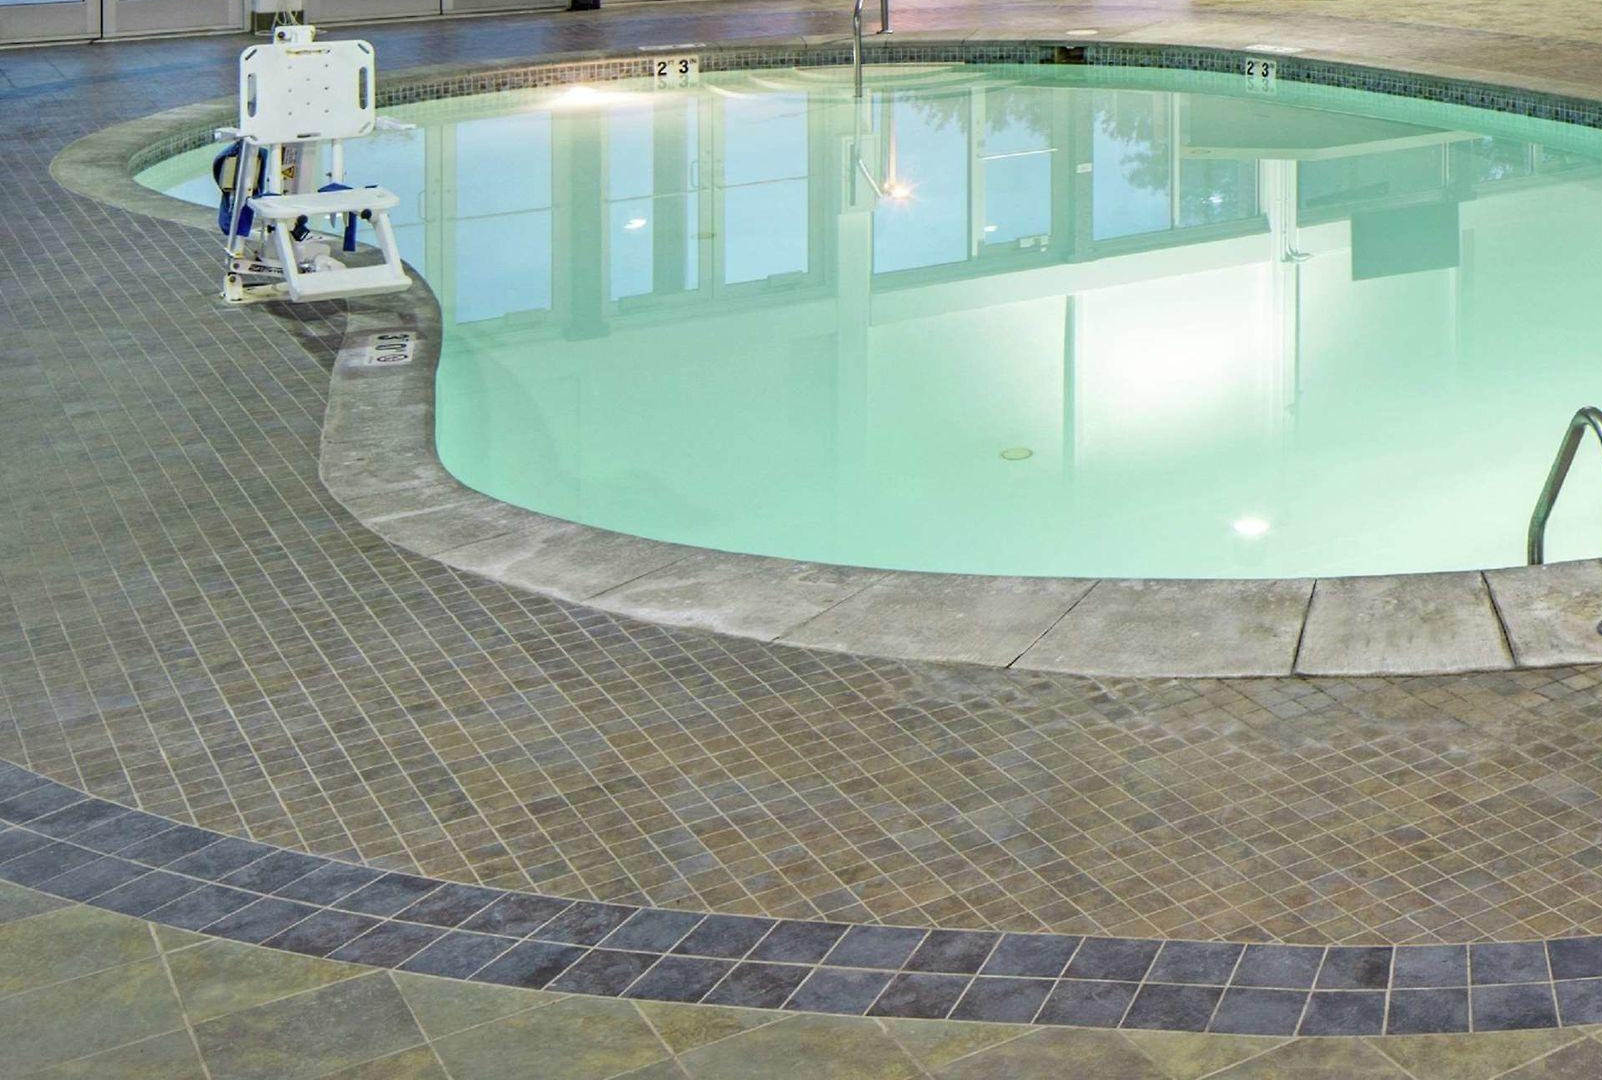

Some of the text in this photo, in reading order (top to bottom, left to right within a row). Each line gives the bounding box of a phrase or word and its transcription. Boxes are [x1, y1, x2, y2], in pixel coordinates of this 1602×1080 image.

[658, 61, 668, 76] 2
[679, 59, 689, 73] 3
[1247, 60, 1254, 75] 2
[1261, 62, 1269, 77] 3
